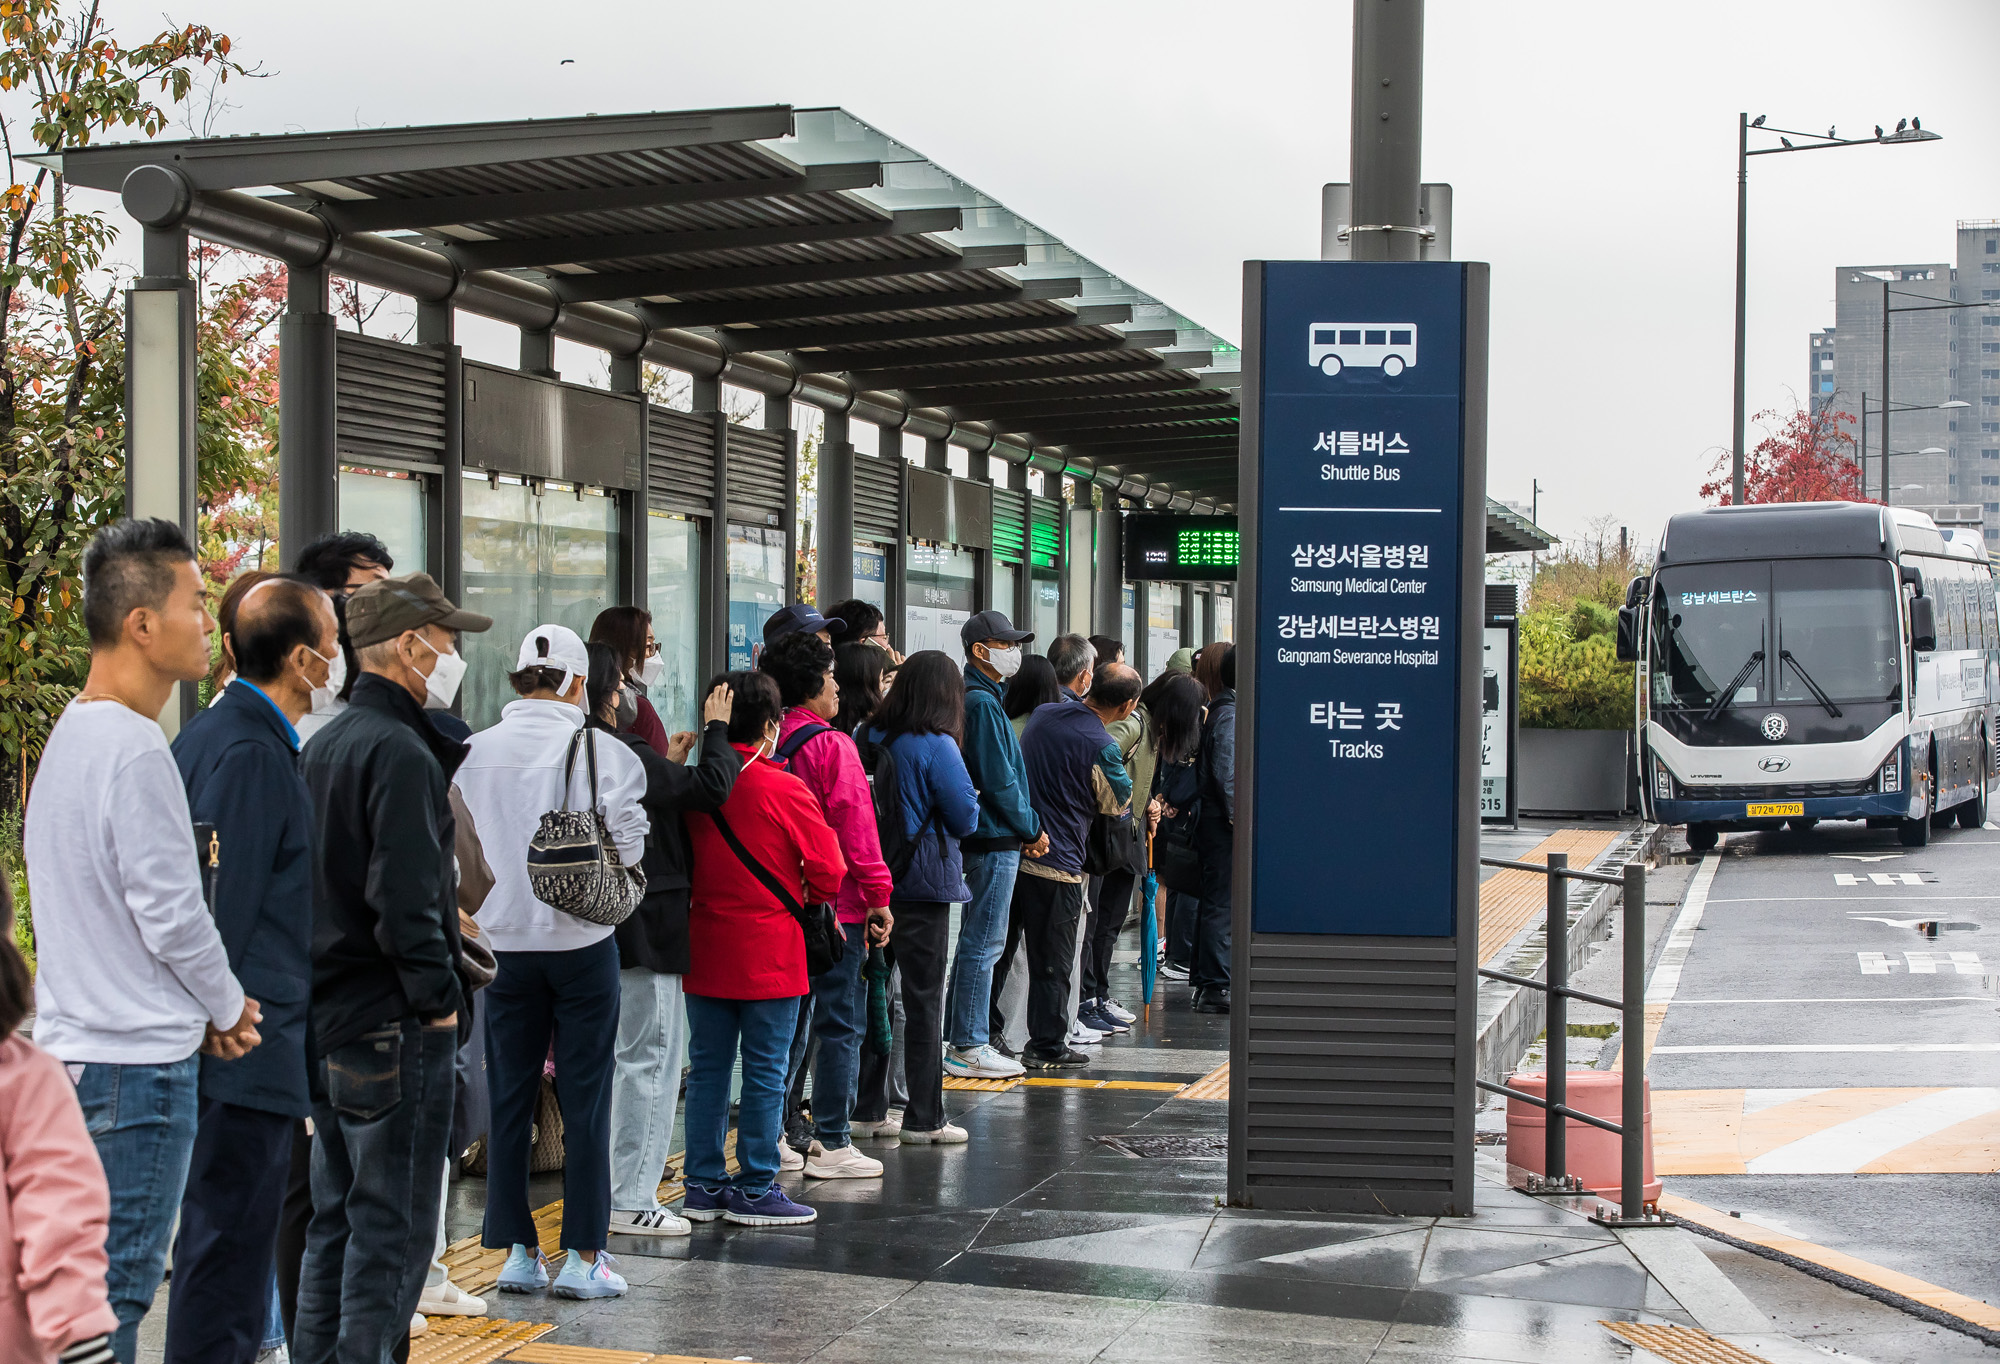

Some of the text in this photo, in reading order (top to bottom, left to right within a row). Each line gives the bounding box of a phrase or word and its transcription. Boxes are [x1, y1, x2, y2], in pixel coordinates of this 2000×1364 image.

[1312, 430, 1410, 457] 셔틀버스
[1320, 463, 1401, 482] Shuttle Bus
[1290, 543, 1430, 569] 삼성서울병원
[1290, 576, 1428, 596] Samsung Medical Center
[1681, 589, 1758, 606] 강남세브란스
[1277, 614, 1440, 641] 강남세브란스병원
[1277, 647, 1439, 668] Gangnam Severance Hospital
[1310, 701, 1404, 731] 타는 곳
[1328, 739, 1384, 759] Tracks
[1481, 798, 1501, 810] 615
[1776, 804, 1800, 814] 7790
